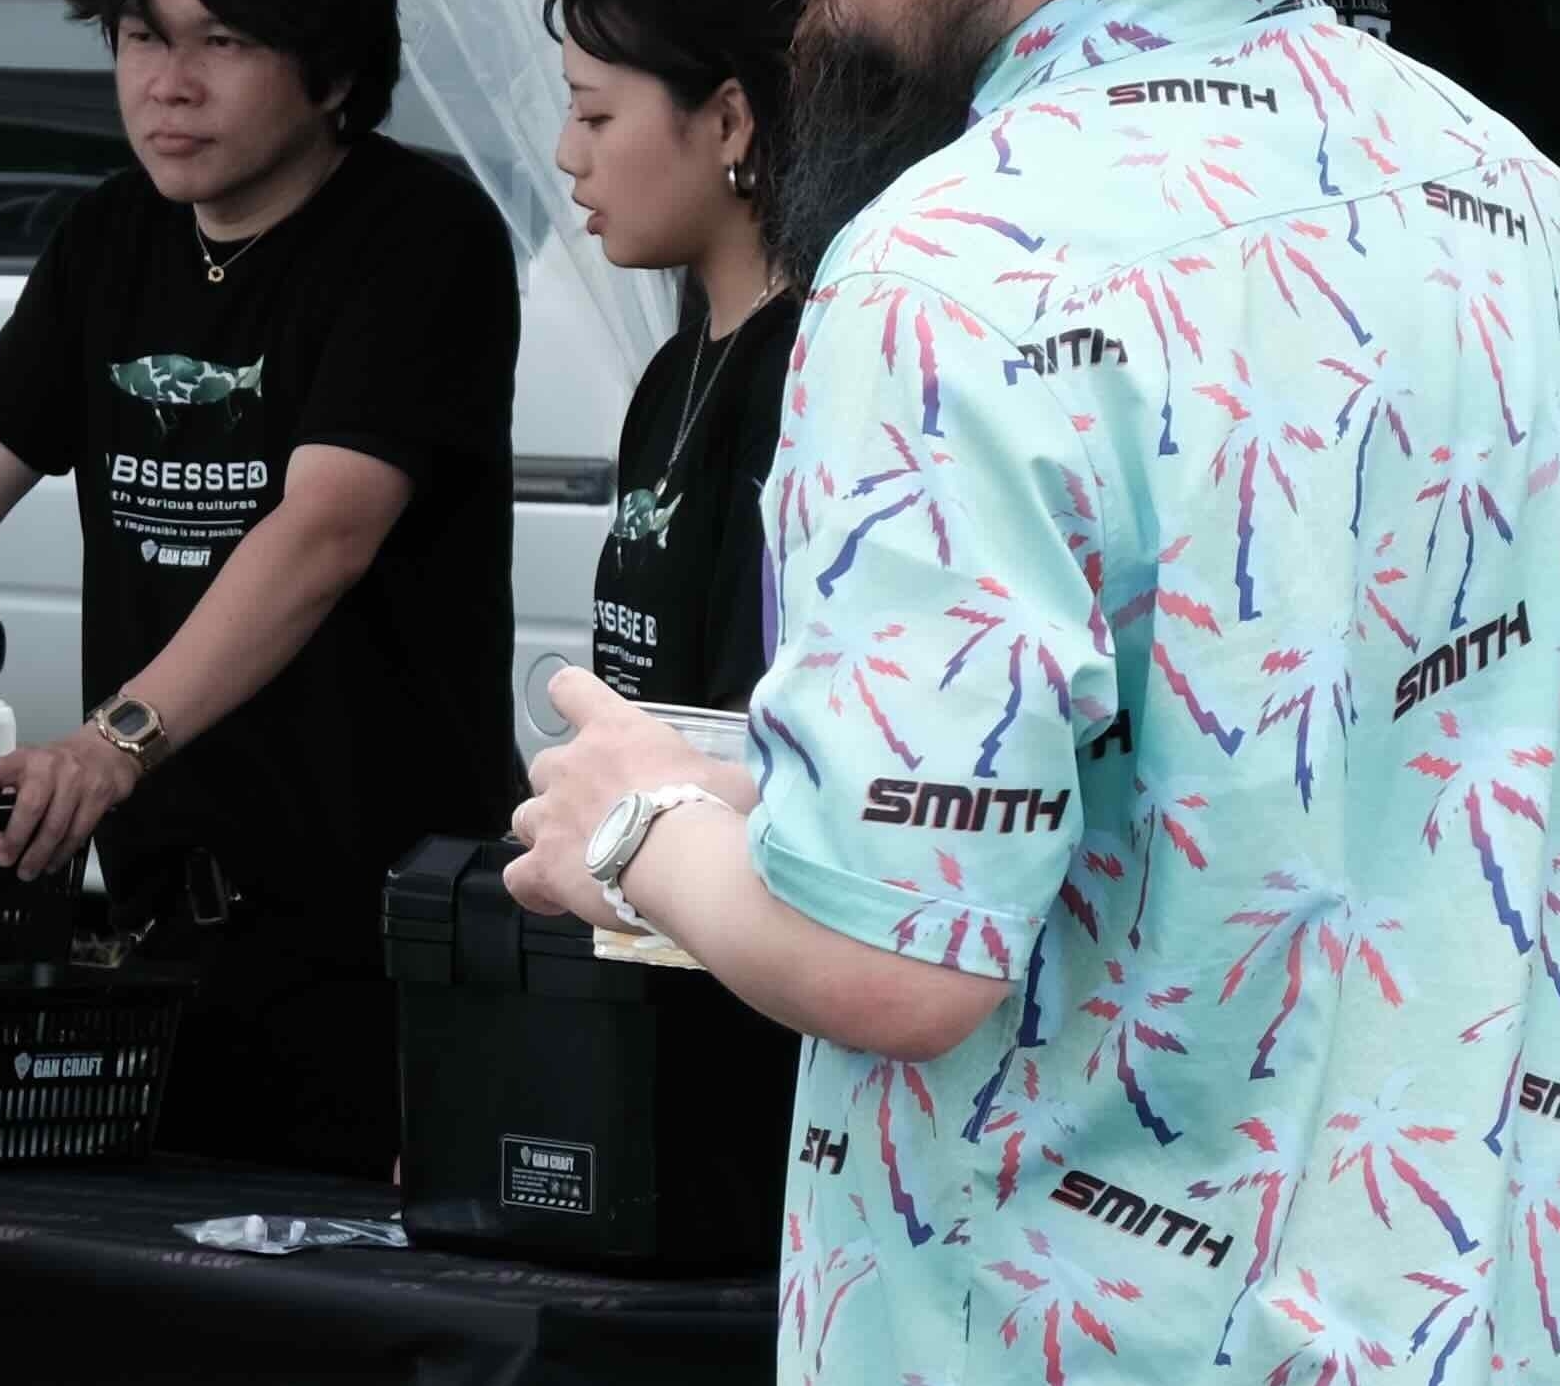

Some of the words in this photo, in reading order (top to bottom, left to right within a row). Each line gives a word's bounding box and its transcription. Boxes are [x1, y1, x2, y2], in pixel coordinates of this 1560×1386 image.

[1106, 77, 1279, 114] SMITH
[1421, 180, 1528, 246] SMITH
[105, 452, 268, 491] BSESSED
[136, 495, 194, 511] various
[196, 498, 258, 511] cultures
[180, 548, 212, 567] CRAFT
[1391, 599, 1533, 725] SMITH
[861, 776, 1071, 835] SMITH
[32, 1058, 61, 1078] GAN
[62, 1056, 104, 1078] CRAFT
[1049, 1168, 1235, 1270] SMITH
